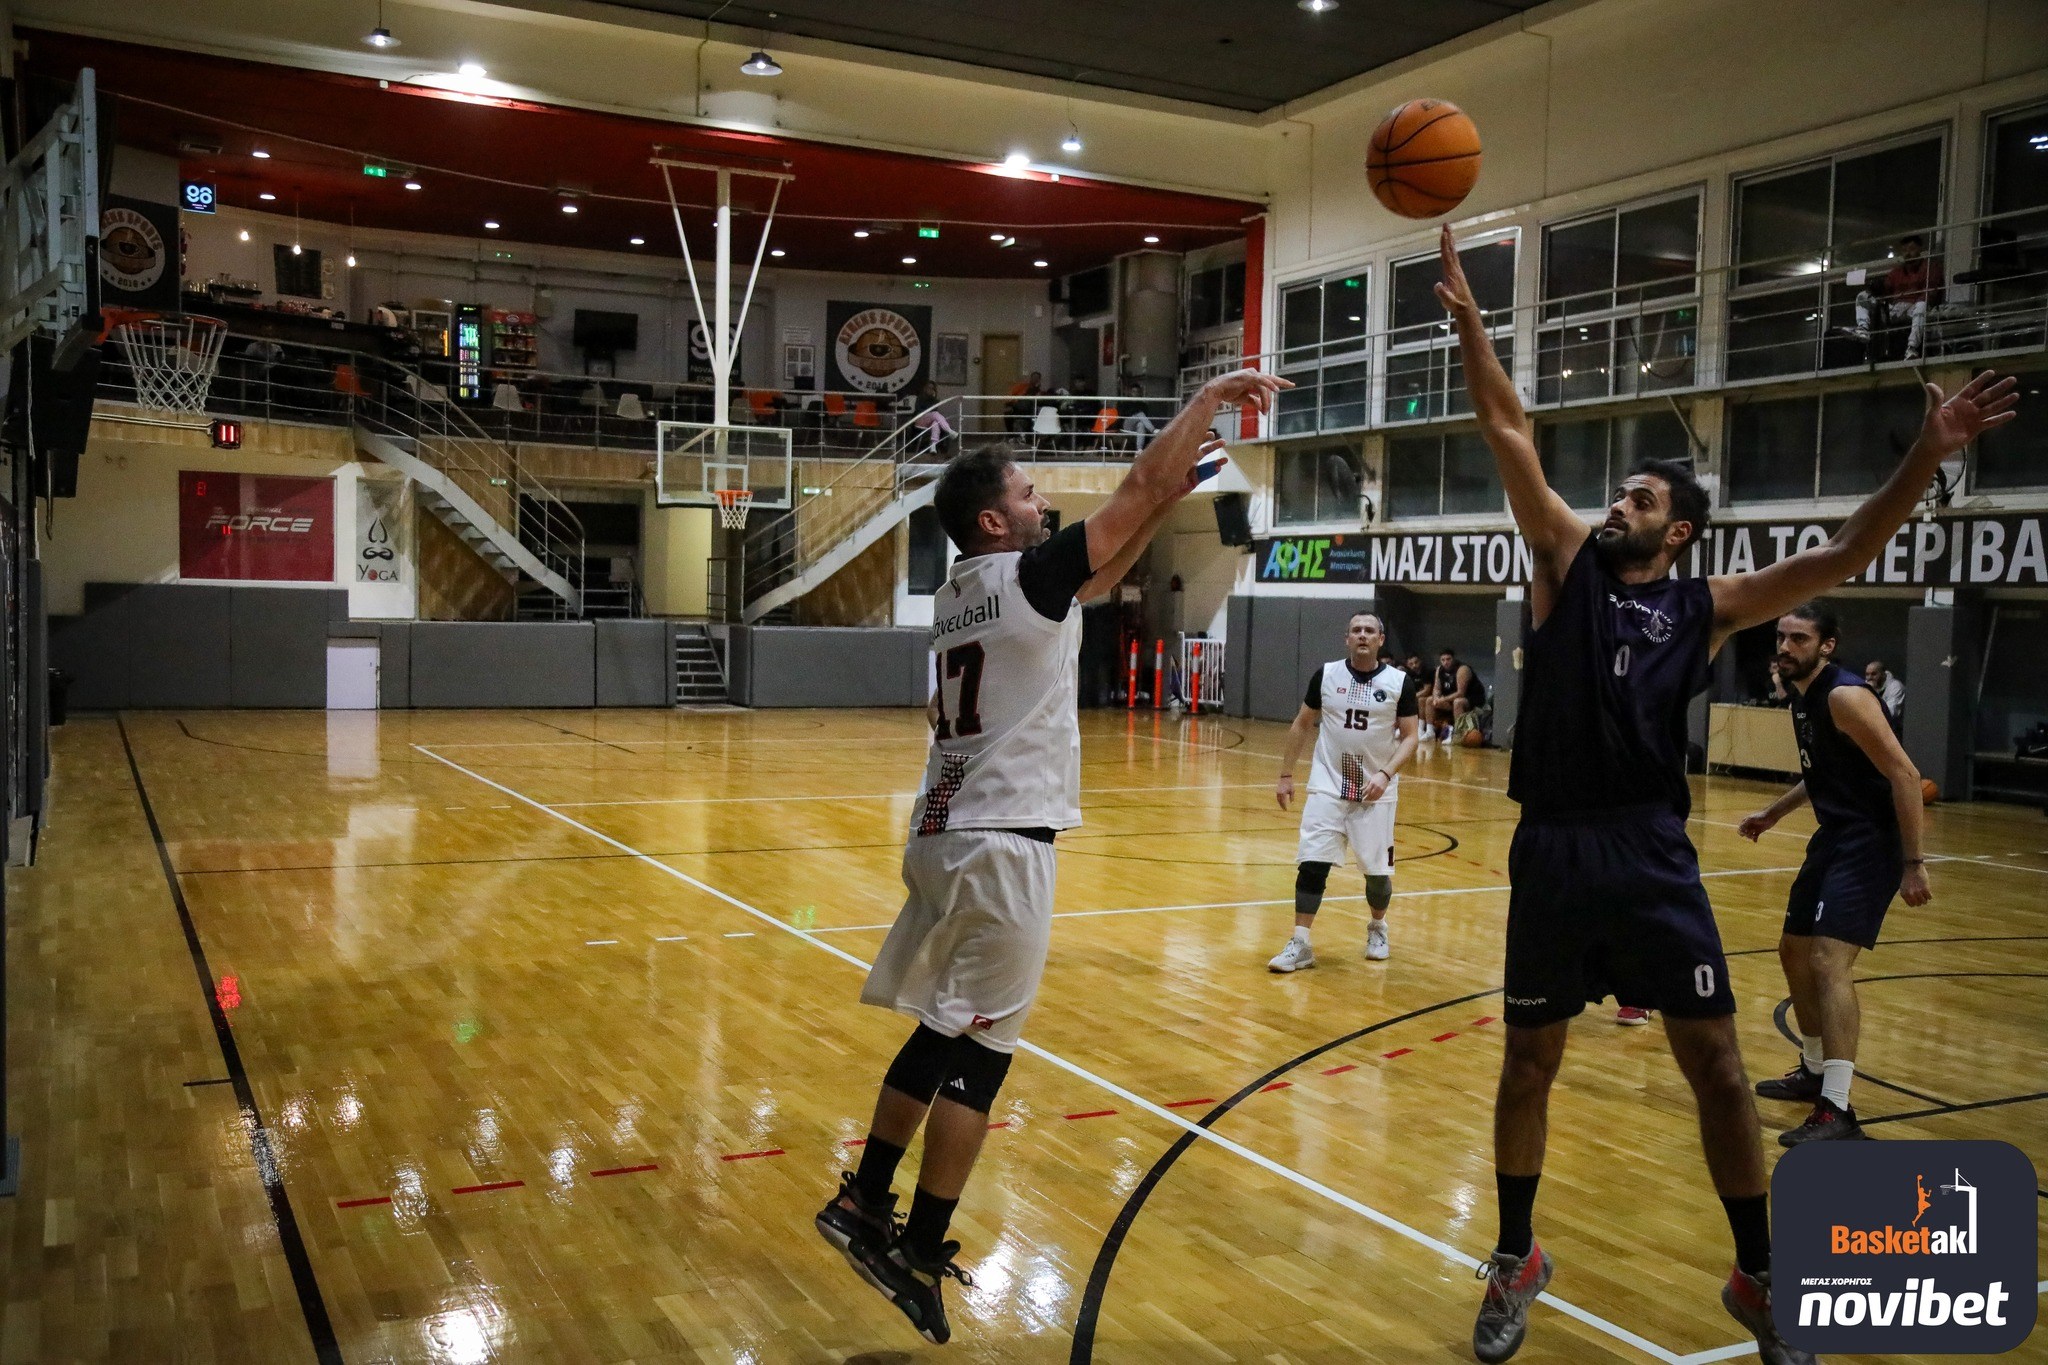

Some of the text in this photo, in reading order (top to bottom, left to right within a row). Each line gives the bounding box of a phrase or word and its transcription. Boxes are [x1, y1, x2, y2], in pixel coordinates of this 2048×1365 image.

[186, 185, 213, 205] 96
[205, 515, 314, 533] FORCE
[1371, 536, 1442, 581] ΜΑΖΙ
[1450, 534, 1533, 582] ΣΤΟΝ
[358, 564, 399, 581] YOGA
[1614, 645, 1630, 677] 0
[1343, 708, 1370, 731] 15
[1695, 964, 1715, 997] 0
